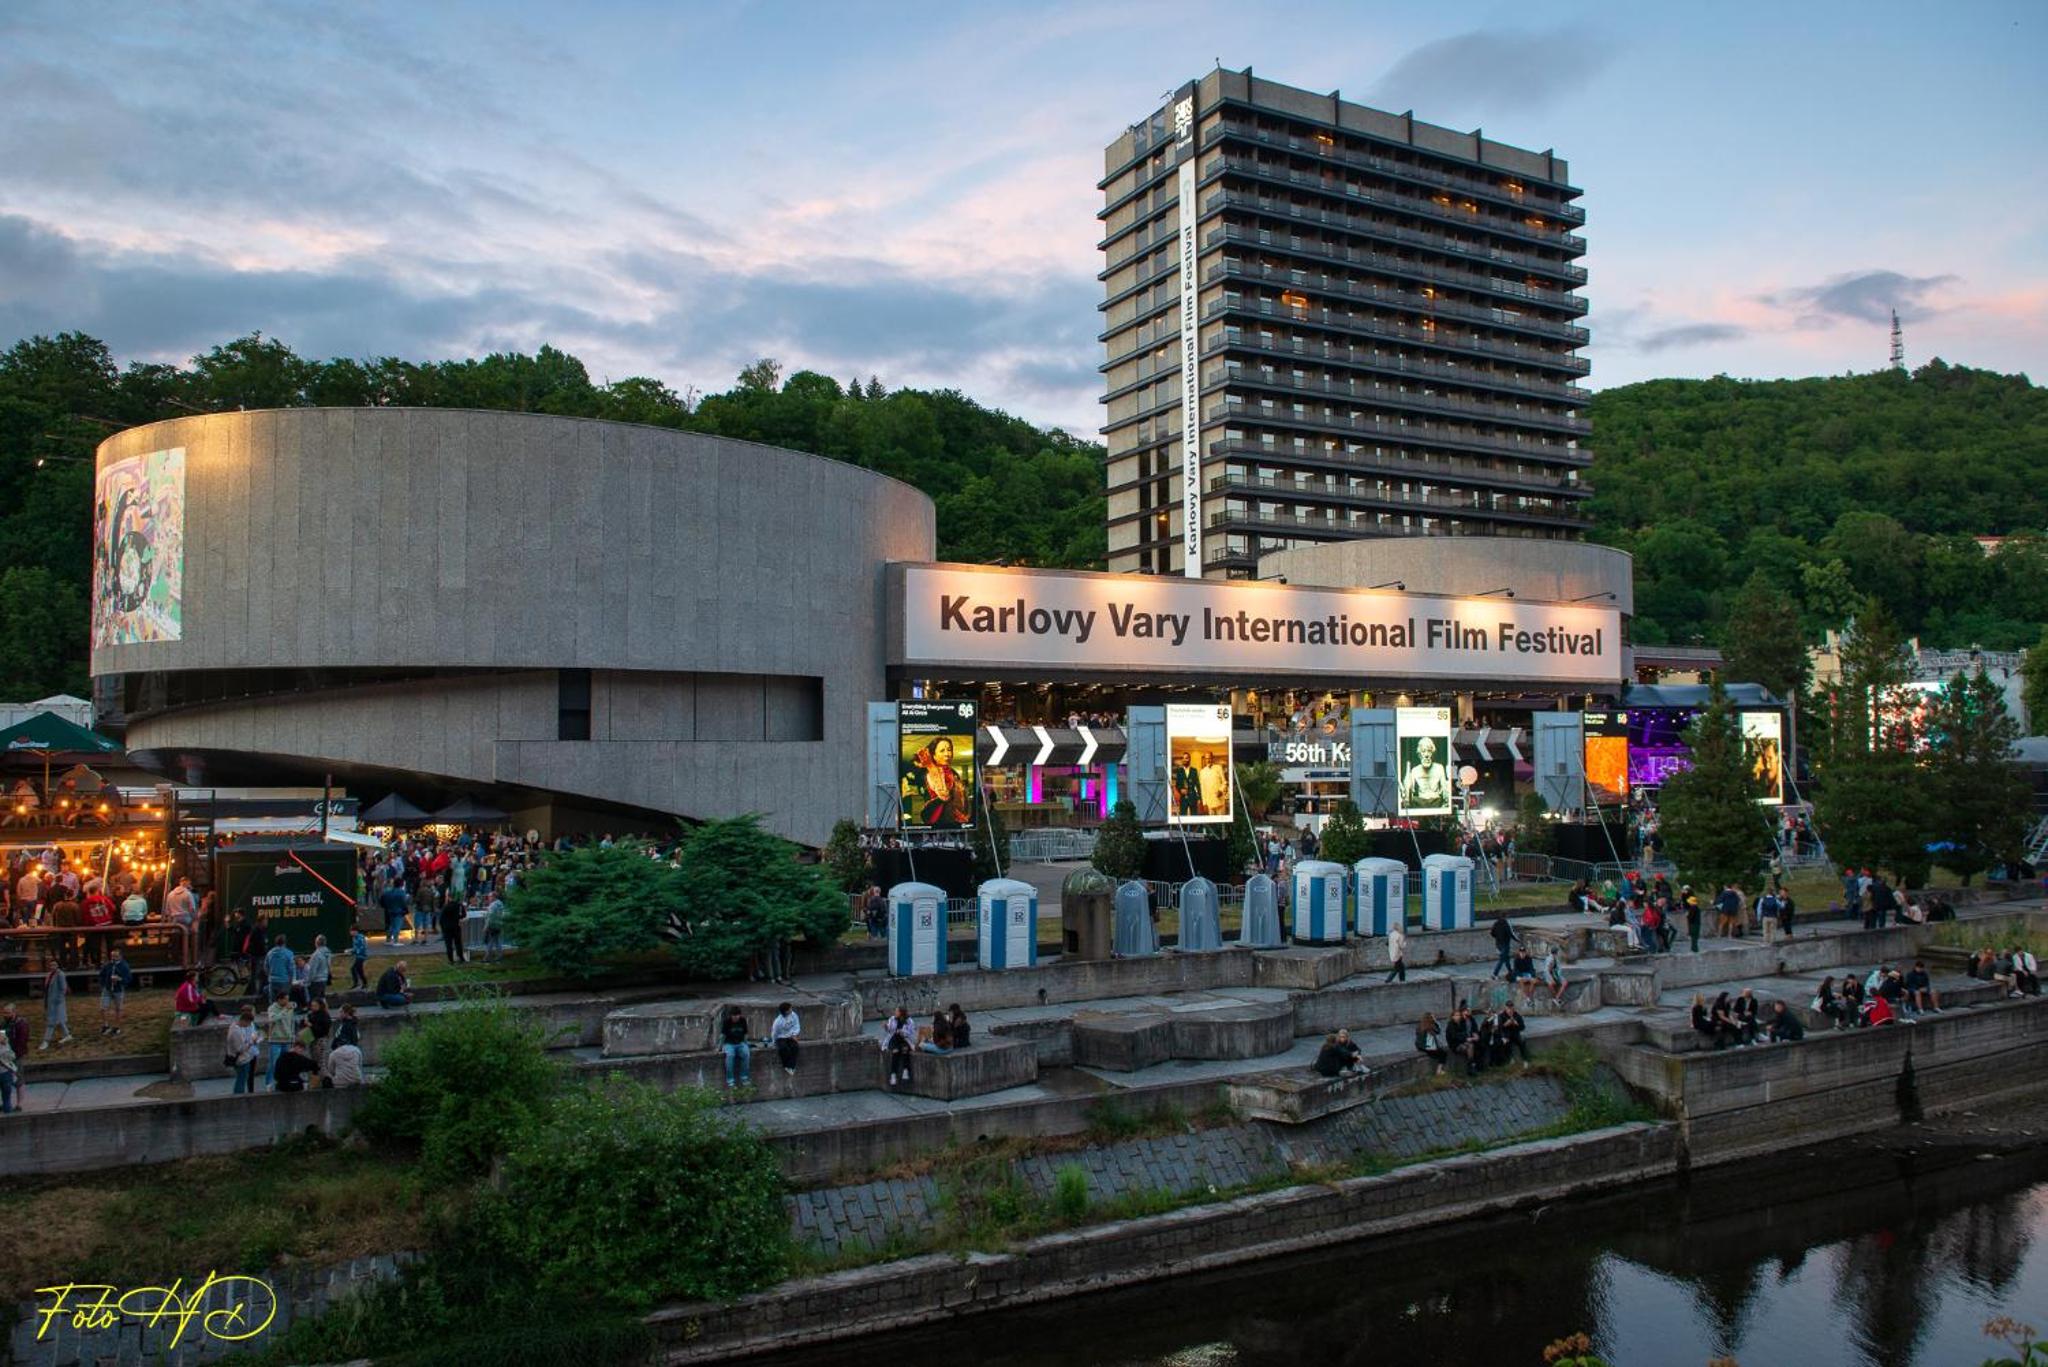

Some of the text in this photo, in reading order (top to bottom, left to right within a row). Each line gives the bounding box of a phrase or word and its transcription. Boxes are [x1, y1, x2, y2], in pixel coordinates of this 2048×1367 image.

[1184, 226, 1197, 555] Karlovy Vary International Film Festival
[941, 595, 1602, 656] Karlovy Vary International Film Festival
[1217, 708, 1230, 721] 56
[1286, 742, 1326, 763] 56th
[252, 896, 282, 906] FILMY
[284, 895, 296, 905] SE
